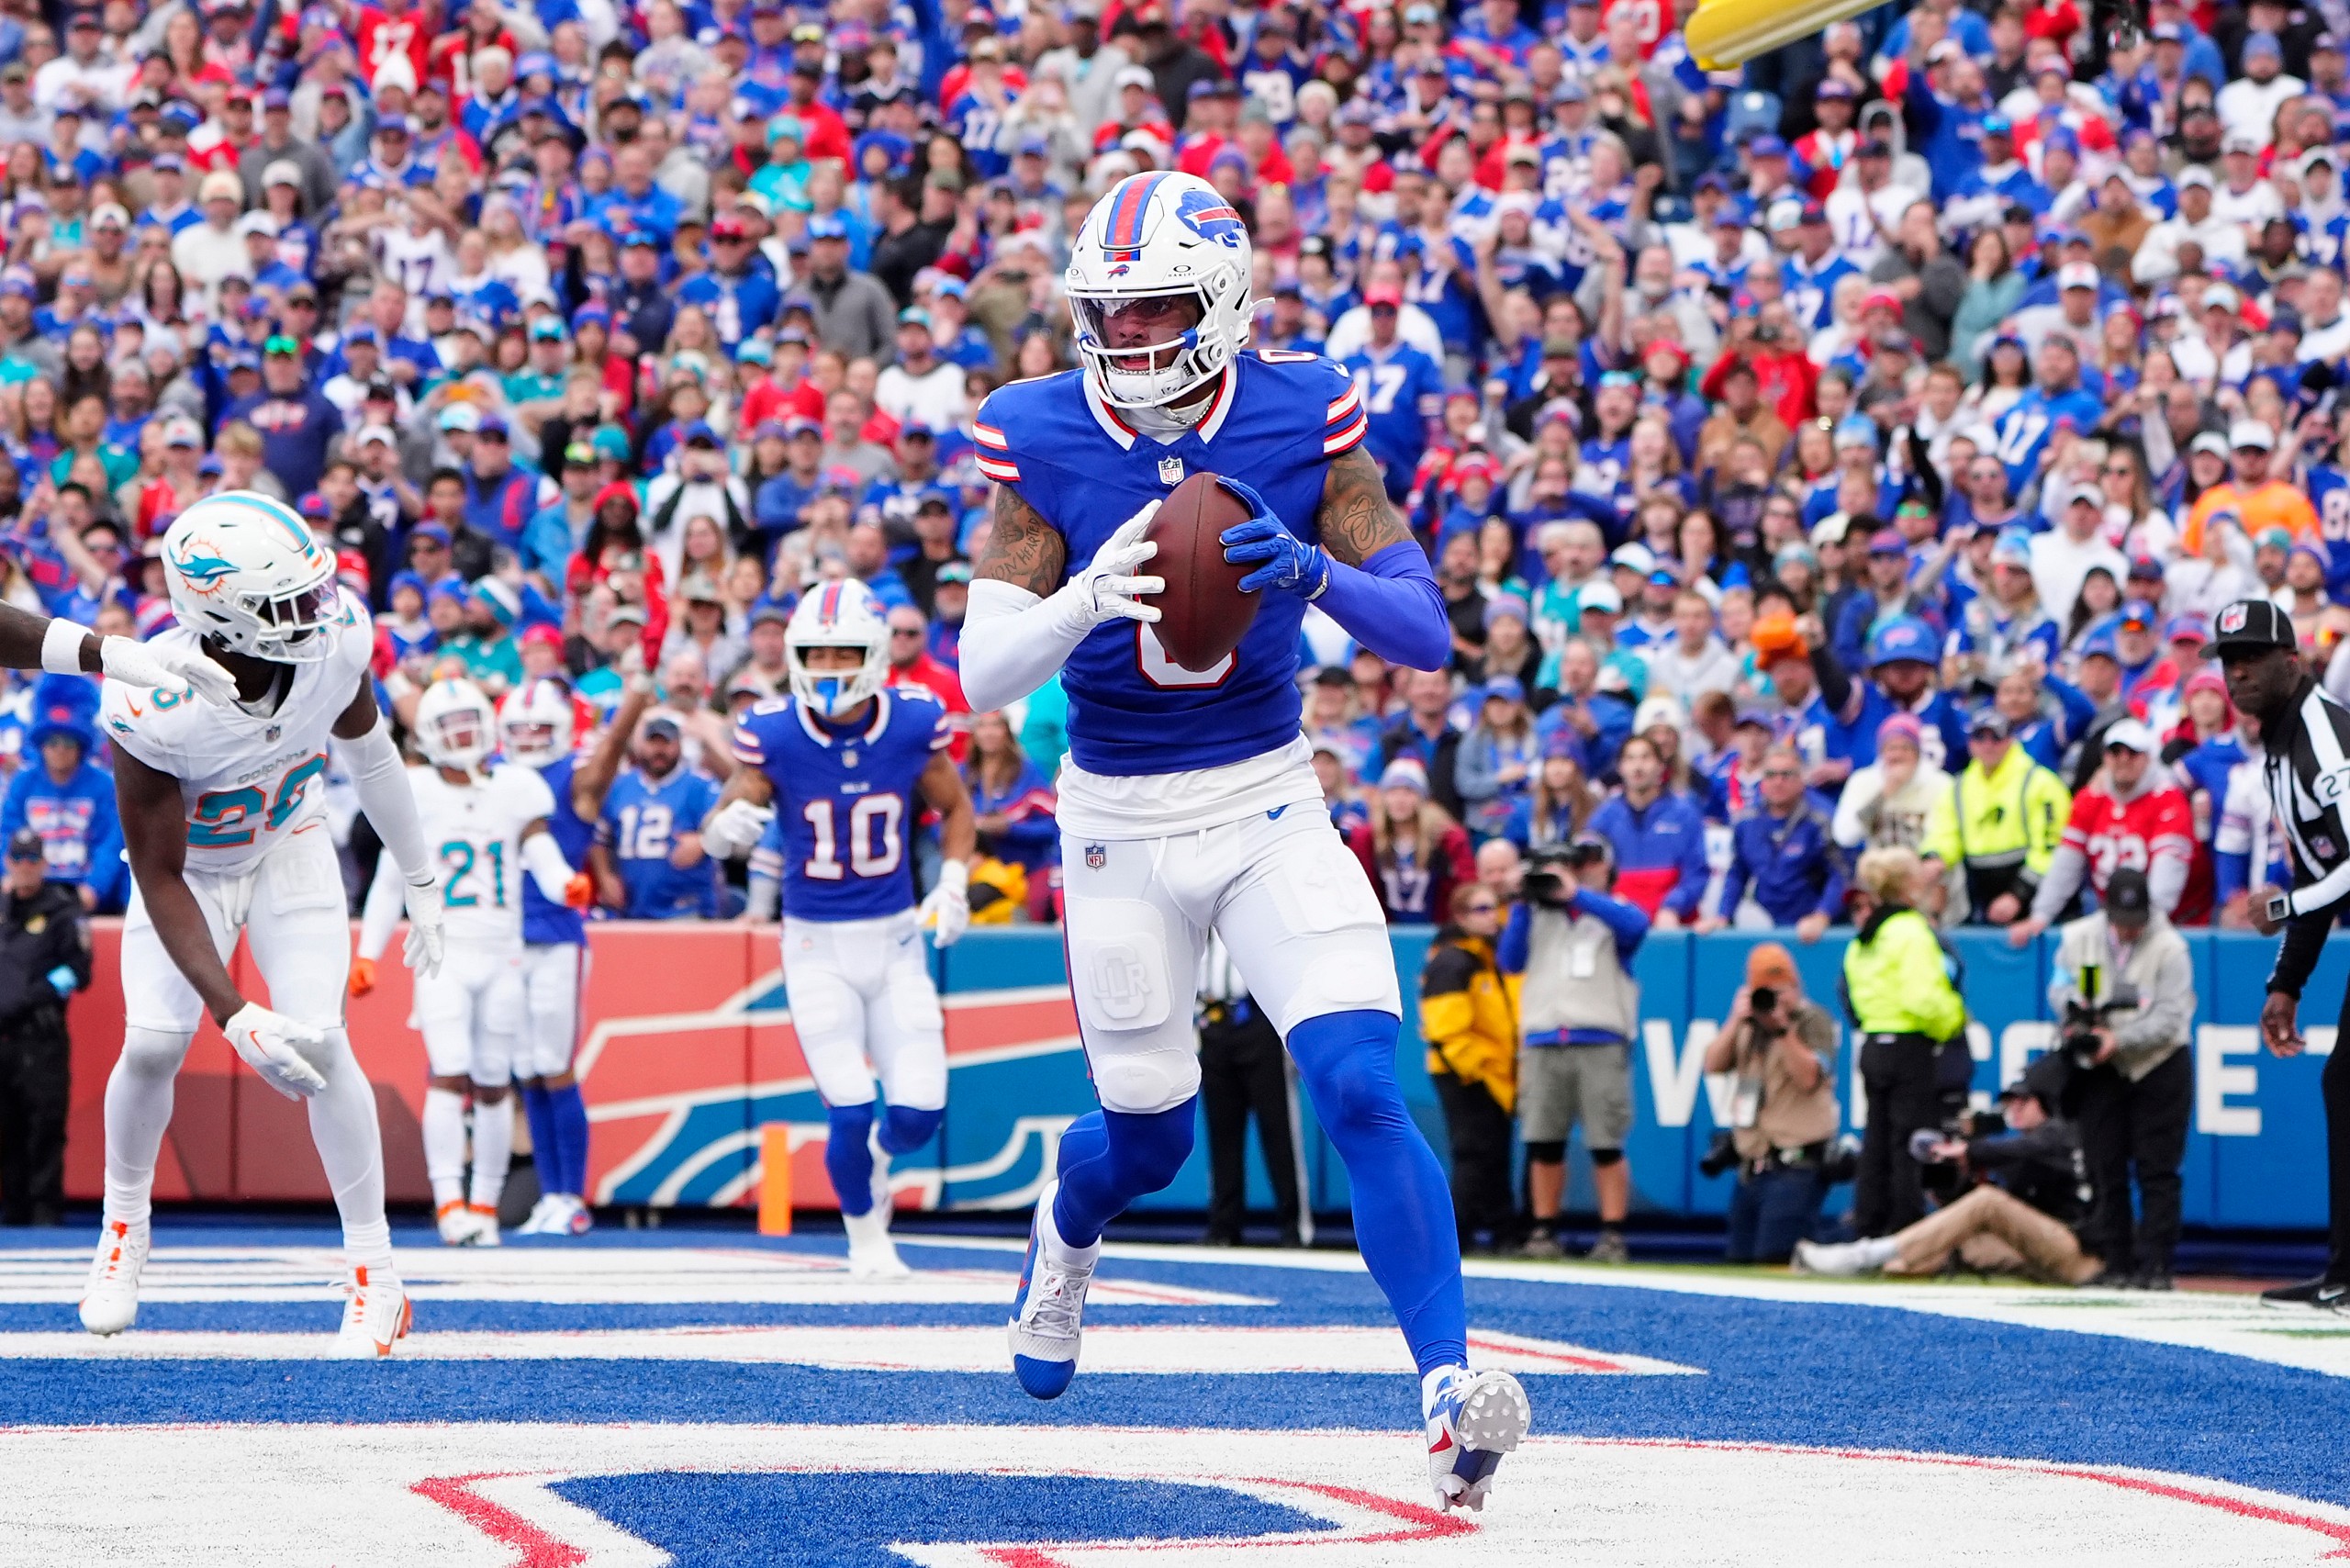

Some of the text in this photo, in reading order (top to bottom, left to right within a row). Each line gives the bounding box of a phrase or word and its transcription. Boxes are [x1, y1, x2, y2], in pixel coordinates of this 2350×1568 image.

[1353, 364, 1407, 415] 17
[1162, 468, 1181, 480] NFL
[617, 804, 672, 859] 12
[804, 792, 903, 879] 10
[441, 840, 505, 907] 21
[1089, 854, 1103, 865] NFL
